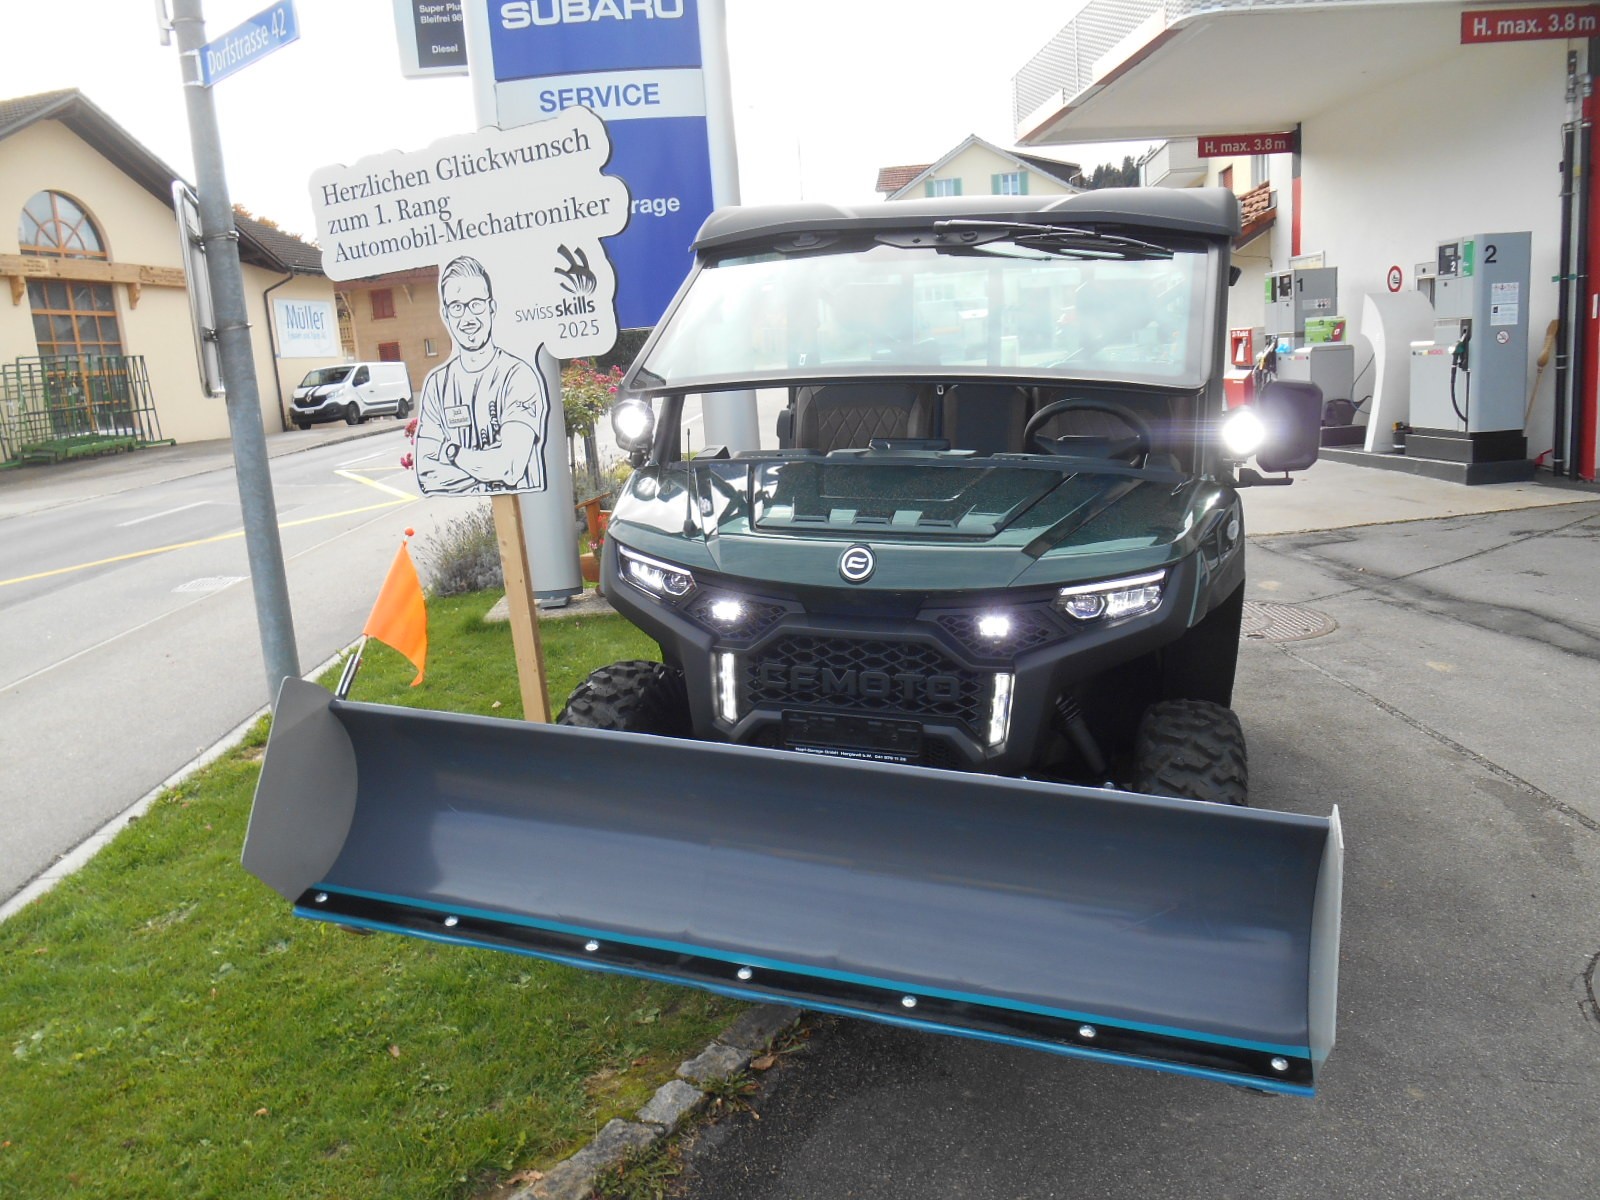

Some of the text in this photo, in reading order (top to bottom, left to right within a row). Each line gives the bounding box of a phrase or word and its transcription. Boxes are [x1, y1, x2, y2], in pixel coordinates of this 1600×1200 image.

[419, 3, 462, 13] Super Plu
[500, 0, 684, 29] SUBARU
[420, 15, 451, 24] Bleifrei
[1473, 17, 1493, 36] H.
[1497, 18, 1543, 35] max.
[207, 8, 287, 75] Dorfstrasse 42
[431, 44, 459, 54] Diesel
[539, 83, 661, 113] SERVICE
[1205, 141, 1218, 153] H.
[1220, 141, 1251, 152] max.
[322, 127, 592, 206] Herzlichen Glückwunsch
[327, 195, 452, 235] zum 1. Rang
[631, 197, 681, 217] rage
[335, 196, 611, 264] Automobil-Mechatroniker
[1484, 244, 1497, 264] 2
[1296, 278, 1304, 292] 1
[285, 304, 325, 330] Müller
[557, 319, 600, 339] 2025
[760, 662, 961, 701] CFMOTO
